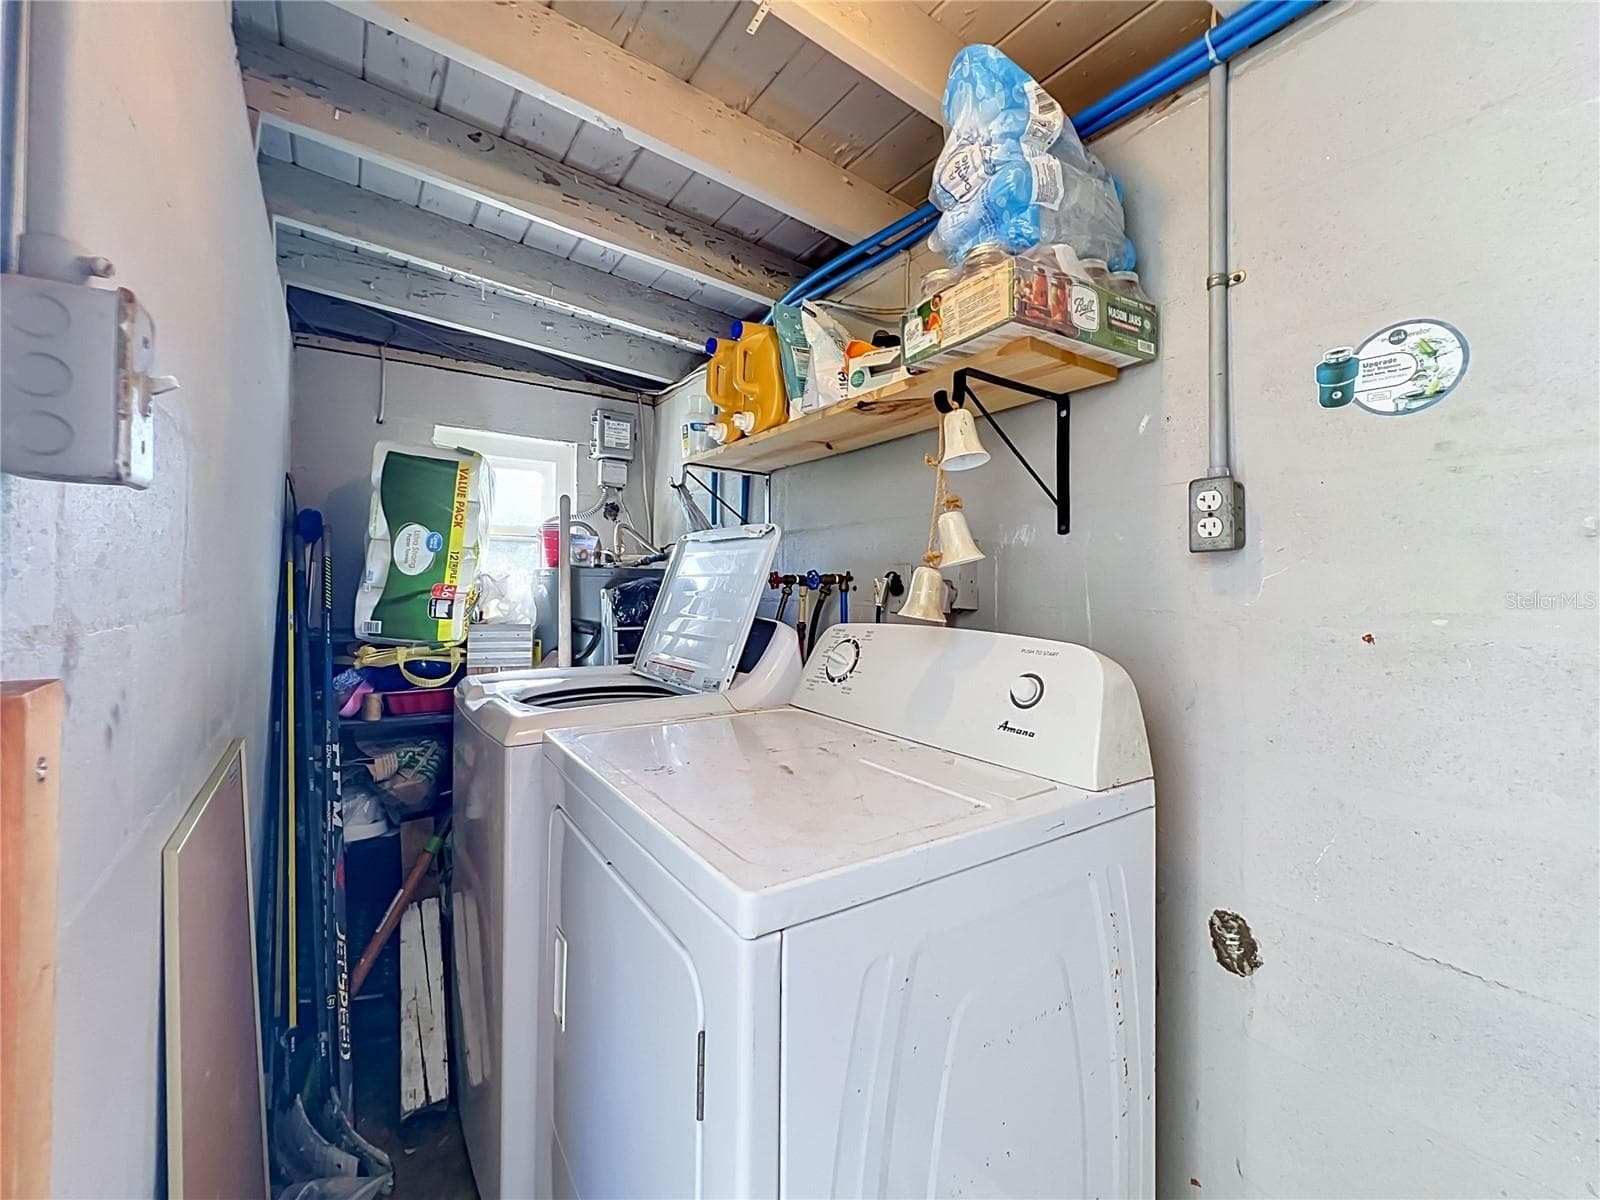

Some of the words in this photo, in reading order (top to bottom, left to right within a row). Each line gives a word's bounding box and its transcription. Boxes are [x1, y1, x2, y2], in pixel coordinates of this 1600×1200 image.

[1073, 297, 1096, 317] Ball
[1107, 306, 1127, 321] MASON
[1127, 312, 1142, 326] JARS
[1362, 358, 1397, 368] Upgrade
[457, 467, 469, 498] VALUE
[453, 501, 465, 528] PACK
[408, 545, 420, 569] Strong
[449, 551, 459, 560] 12
[449, 561, 459, 579] TRIPLE
[441, 585, 455, 598] 36
[997, 720, 1036, 738] Amana
